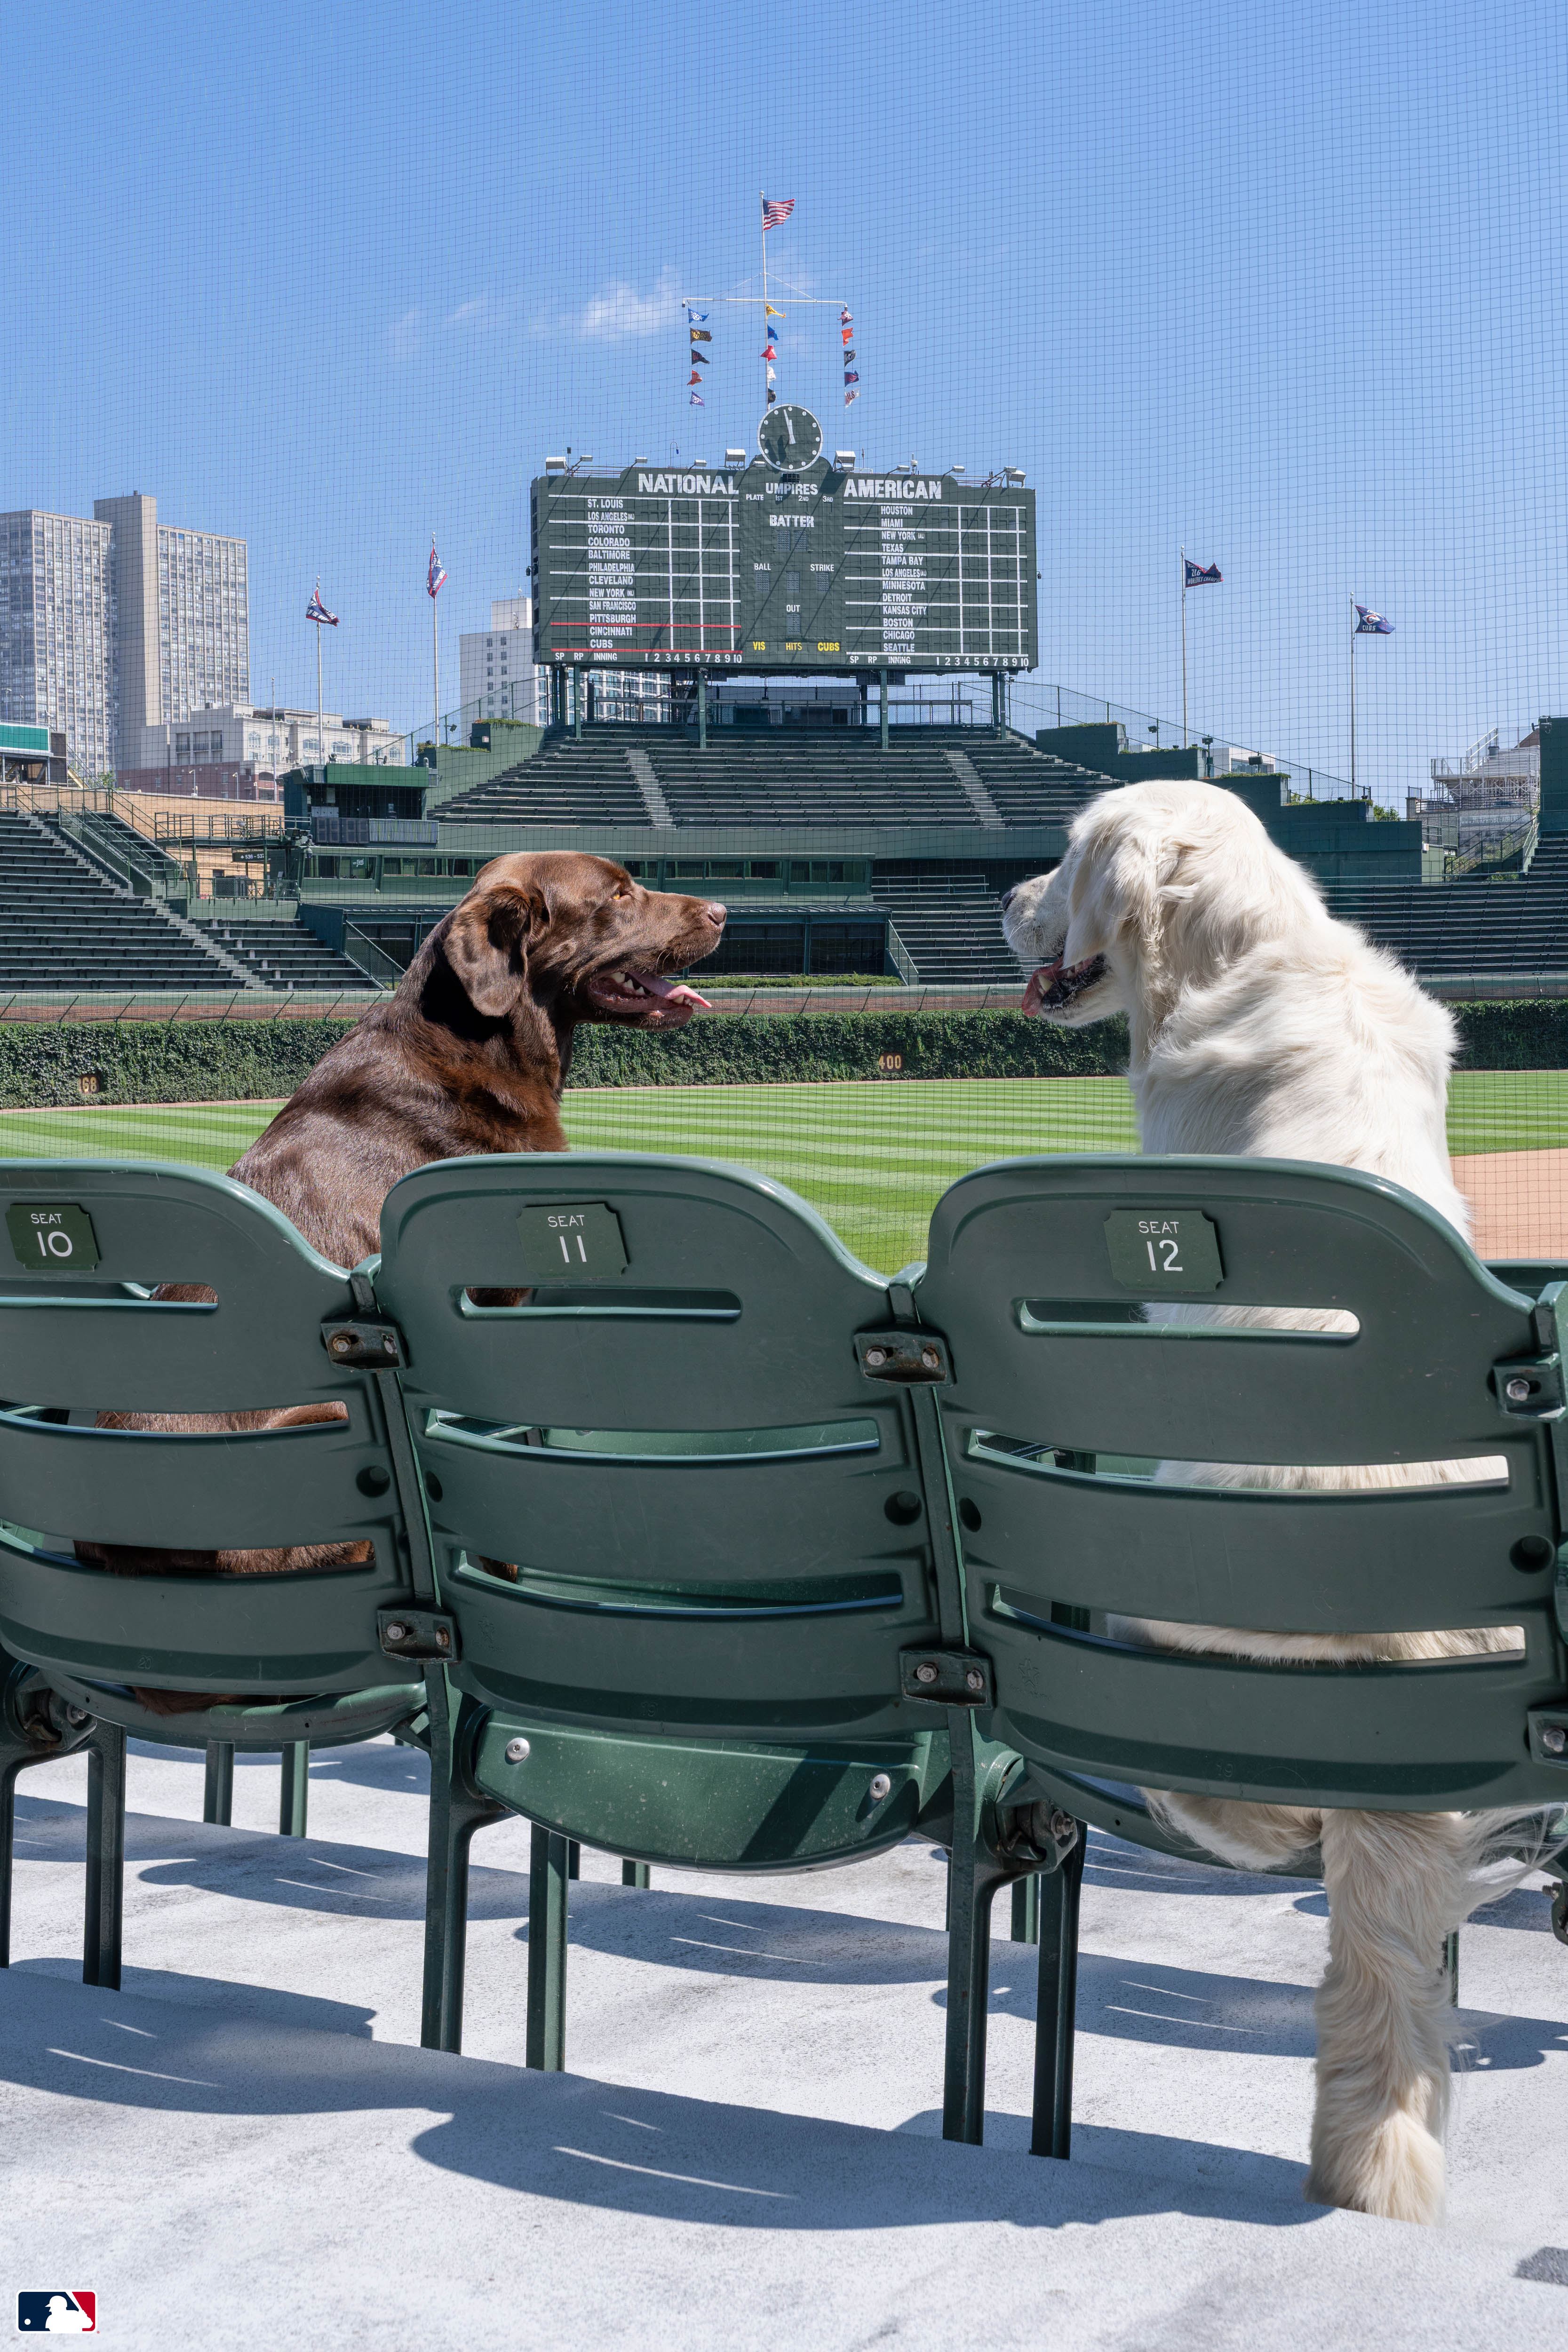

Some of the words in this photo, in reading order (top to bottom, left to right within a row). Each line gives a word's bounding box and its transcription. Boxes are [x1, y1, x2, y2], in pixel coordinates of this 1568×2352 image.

[639, 474, 739, 494] NATIONAL
[766, 484, 818, 495] UMPIRES
[844, 479, 941, 499] AMERICAN
[588, 499, 598, 508] ST.
[601, 499, 623, 508] LOUIS
[881, 506, 912, 515] HOUSTON
[588, 512, 599, 520] LOS
[601, 512, 627, 521] ANGELES
[770, 515, 814, 527] BATTER
[882, 518, 902, 527] MIAMI
[588, 524, 624, 534] TORONTO
[882, 531, 896, 540] NEW
[898, 532, 915, 540] YORK
[588, 537, 630, 547] COLORADO
[882, 544, 903, 552] TEXAS
[589, 550, 630, 559] BALTIMORE
[882, 556, 907, 564] TAMPA
[909, 556, 923, 565] BAY
[589, 563, 635, 572] PHILADELPHIA
[883, 568, 893, 577] LOS
[895, 569, 920, 578] ANGELES
[589, 576, 633, 585] CLEVELAND
[883, 581, 925, 590] MINNESOTA
[589, 588, 604, 597] NEW
[606, 588, 625, 597] YORK
[883, 593, 912, 602] DETROIT
[589, 601, 601, 610] SAN
[603, 601, 636, 610] FRANCISCO
[883, 606, 910, 614] KANSAS
[912, 606, 926, 614] CITY
[590, 614, 636, 623] PITTSBURGH
[883, 618, 913, 627] BOSTON
[590, 627, 632, 636] CINCINNATI
[883, 631, 915, 640] CHICAGO
[590, 639, 613, 648] CUBS
[753, 642, 765, 650] VIS
[818, 643, 839, 651] CUBS
[884, 643, 915, 652] SEATTLE
[645, 653, 648, 662] 1
[654, 653, 660, 662] 2
[666, 653, 671, 662] 3
[674, 653, 680, 662] 4
[685, 653, 690, 662] 5
[695, 654, 700, 662] 6
[705, 654, 710, 662] 7
[725, 654, 730, 663] 9
[734, 654, 742, 663] 10
[955, 657, 960, 666] 3
[964, 657, 970, 666] 4
[993, 658, 998, 666] 7
[1003, 658, 1008, 666] 8
[879, 1055, 901, 1069] 400
[31, 1214, 61, 1224] SEAT
[548, 1215, 584, 1227] SEAT
[1139, 1221, 1178, 1233] SEAT
[37, 1232, 72, 1256] 10
[560, 1236, 587, 1263] 11
[1147, 1240, 1183, 1271] 12
